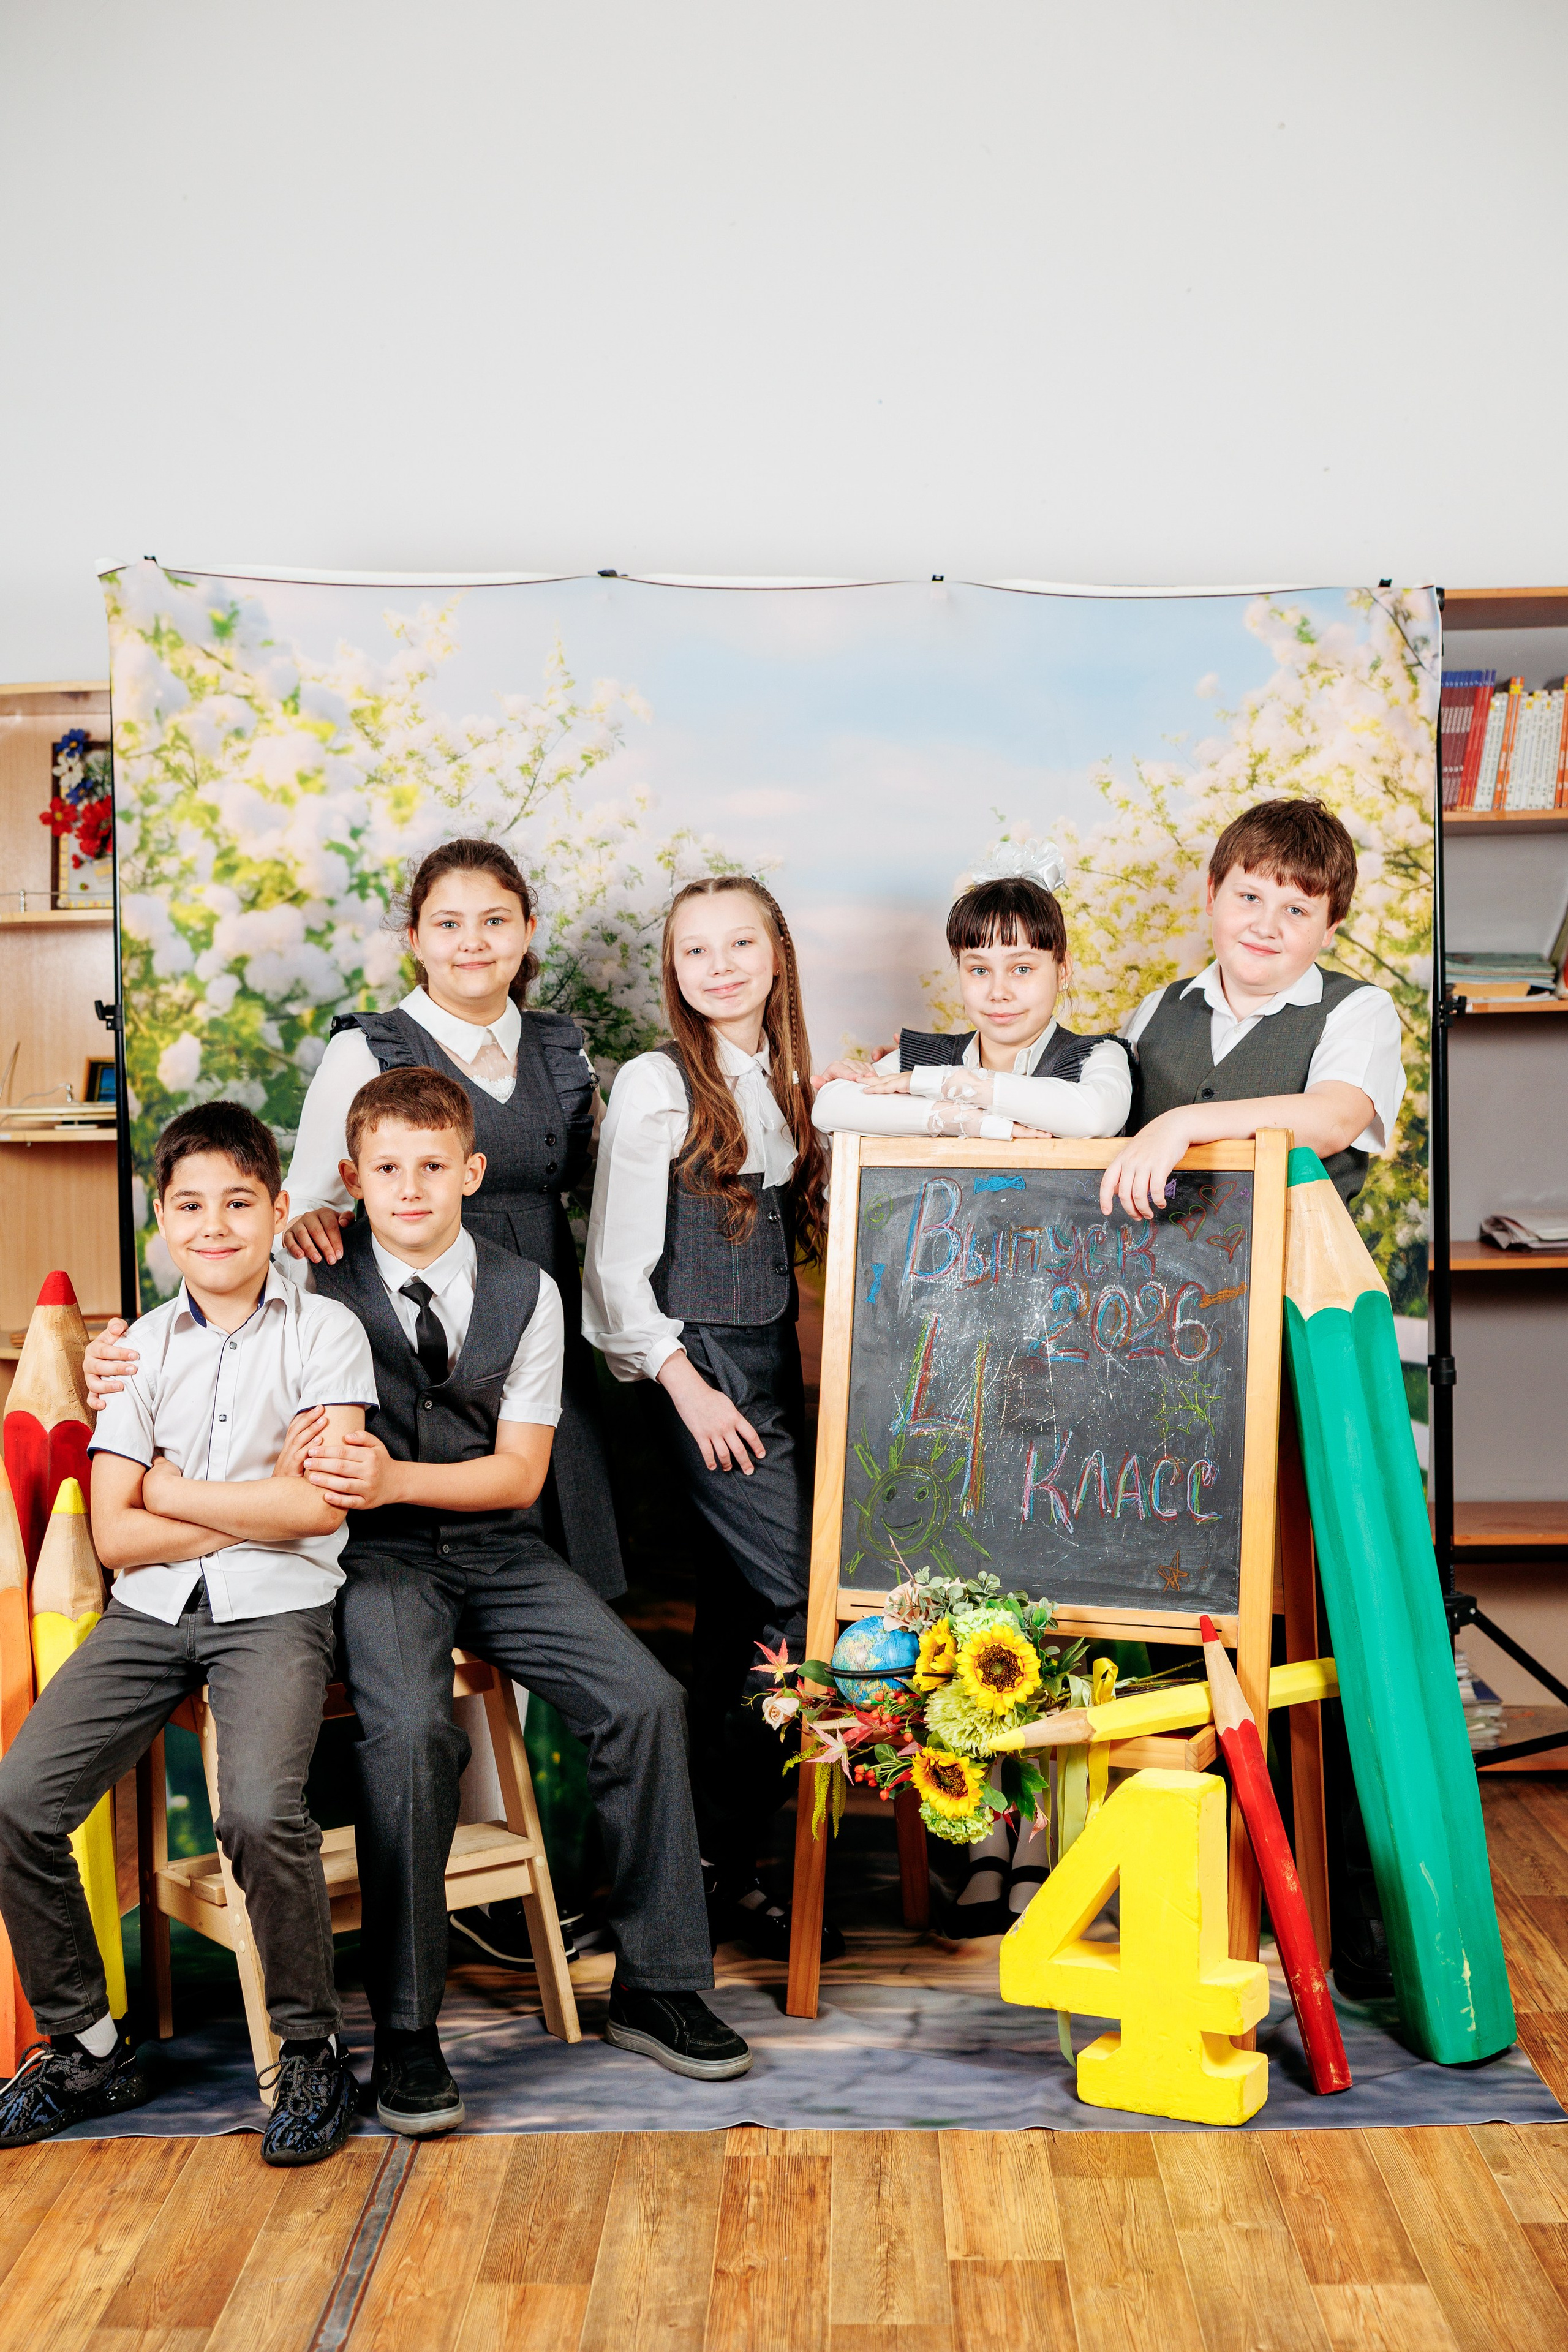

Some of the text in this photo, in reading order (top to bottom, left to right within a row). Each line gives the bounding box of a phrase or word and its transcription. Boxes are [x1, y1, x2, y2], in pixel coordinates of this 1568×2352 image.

[903, 1175, 1158, 1289] Выпуск
[1027, 1280, 1220, 1364] 2026
[889, 1312, 991, 1518] 4
[1000, 1767, 1269, 2126] 4
